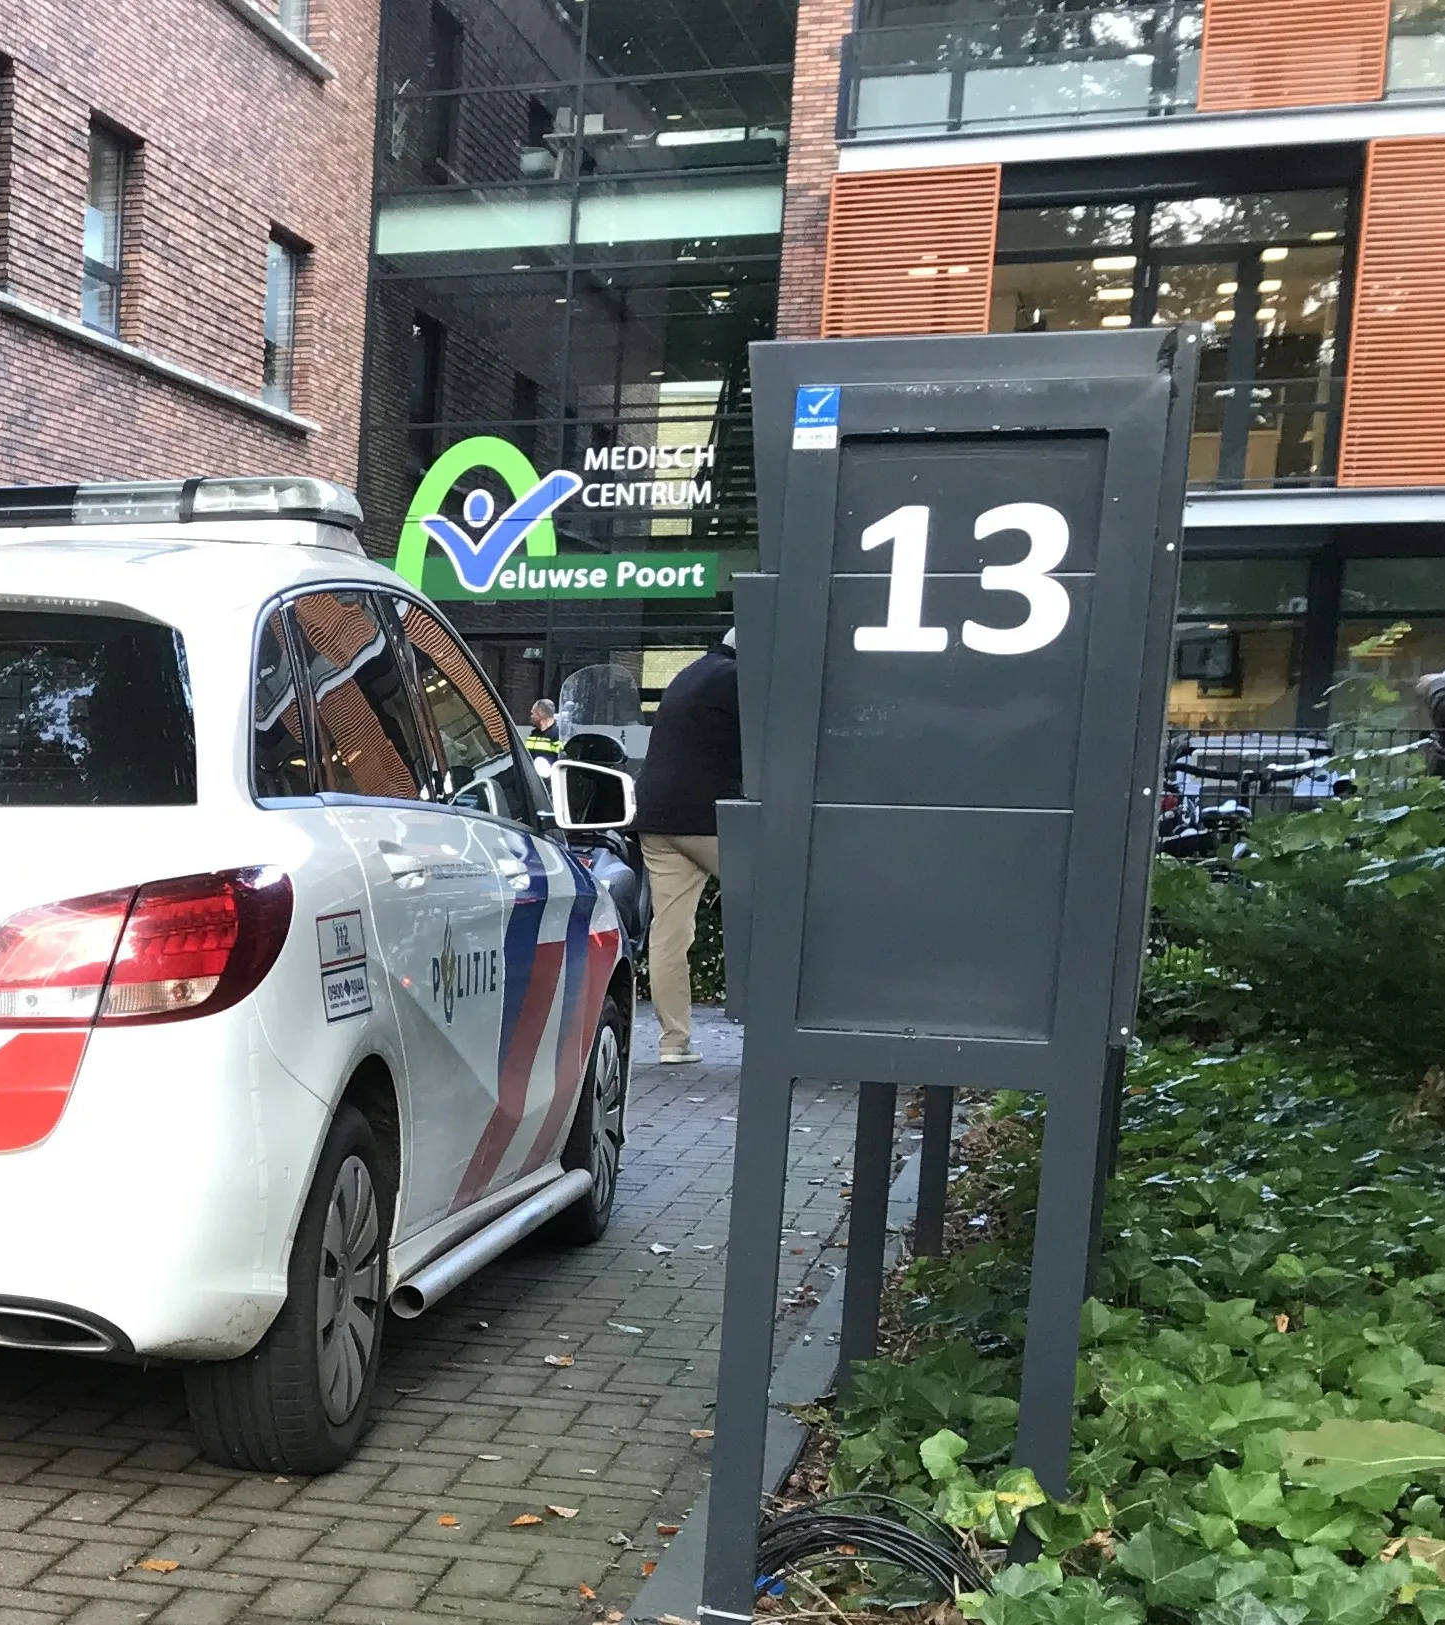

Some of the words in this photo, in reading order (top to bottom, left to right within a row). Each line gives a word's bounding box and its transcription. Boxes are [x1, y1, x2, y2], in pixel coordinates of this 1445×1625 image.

[583, 444, 715, 471] MEDISCH
[582, 480, 712, 507] CENTRUM
[616, 560, 705, 588] Poort
[853, 502, 1071, 655] 13
